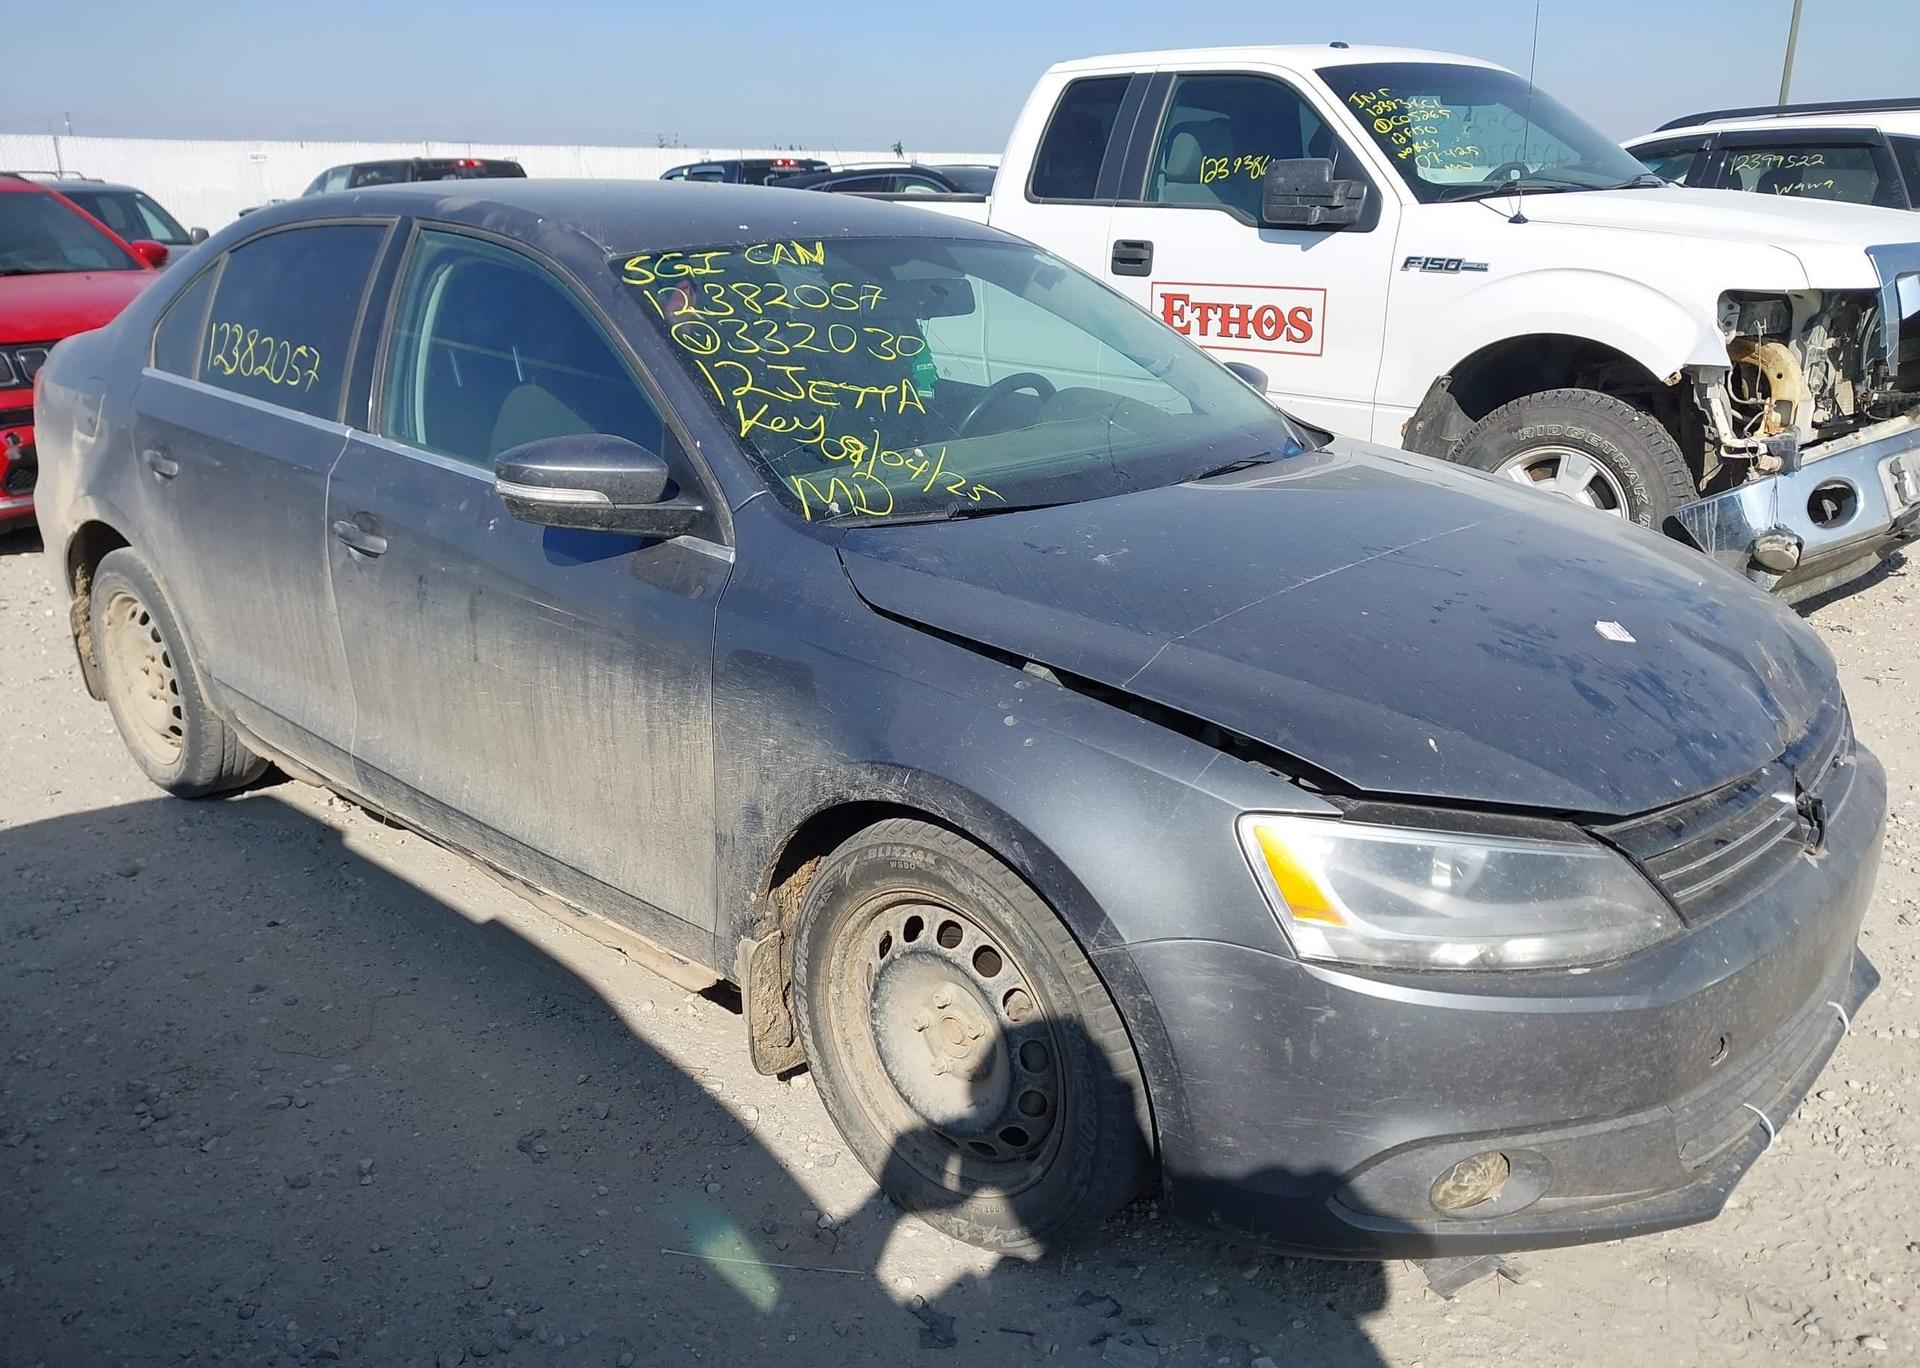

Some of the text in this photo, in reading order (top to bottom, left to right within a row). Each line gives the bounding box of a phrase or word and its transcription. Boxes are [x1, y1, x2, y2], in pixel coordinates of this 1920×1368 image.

[1200, 154, 1275, 185] 1239386
[621, 241, 825, 285] SGI CAN
[644, 282, 888, 320] 12382057
[1159, 292, 1314, 343] ETHOS
[207, 322, 320, 393] 12382057
